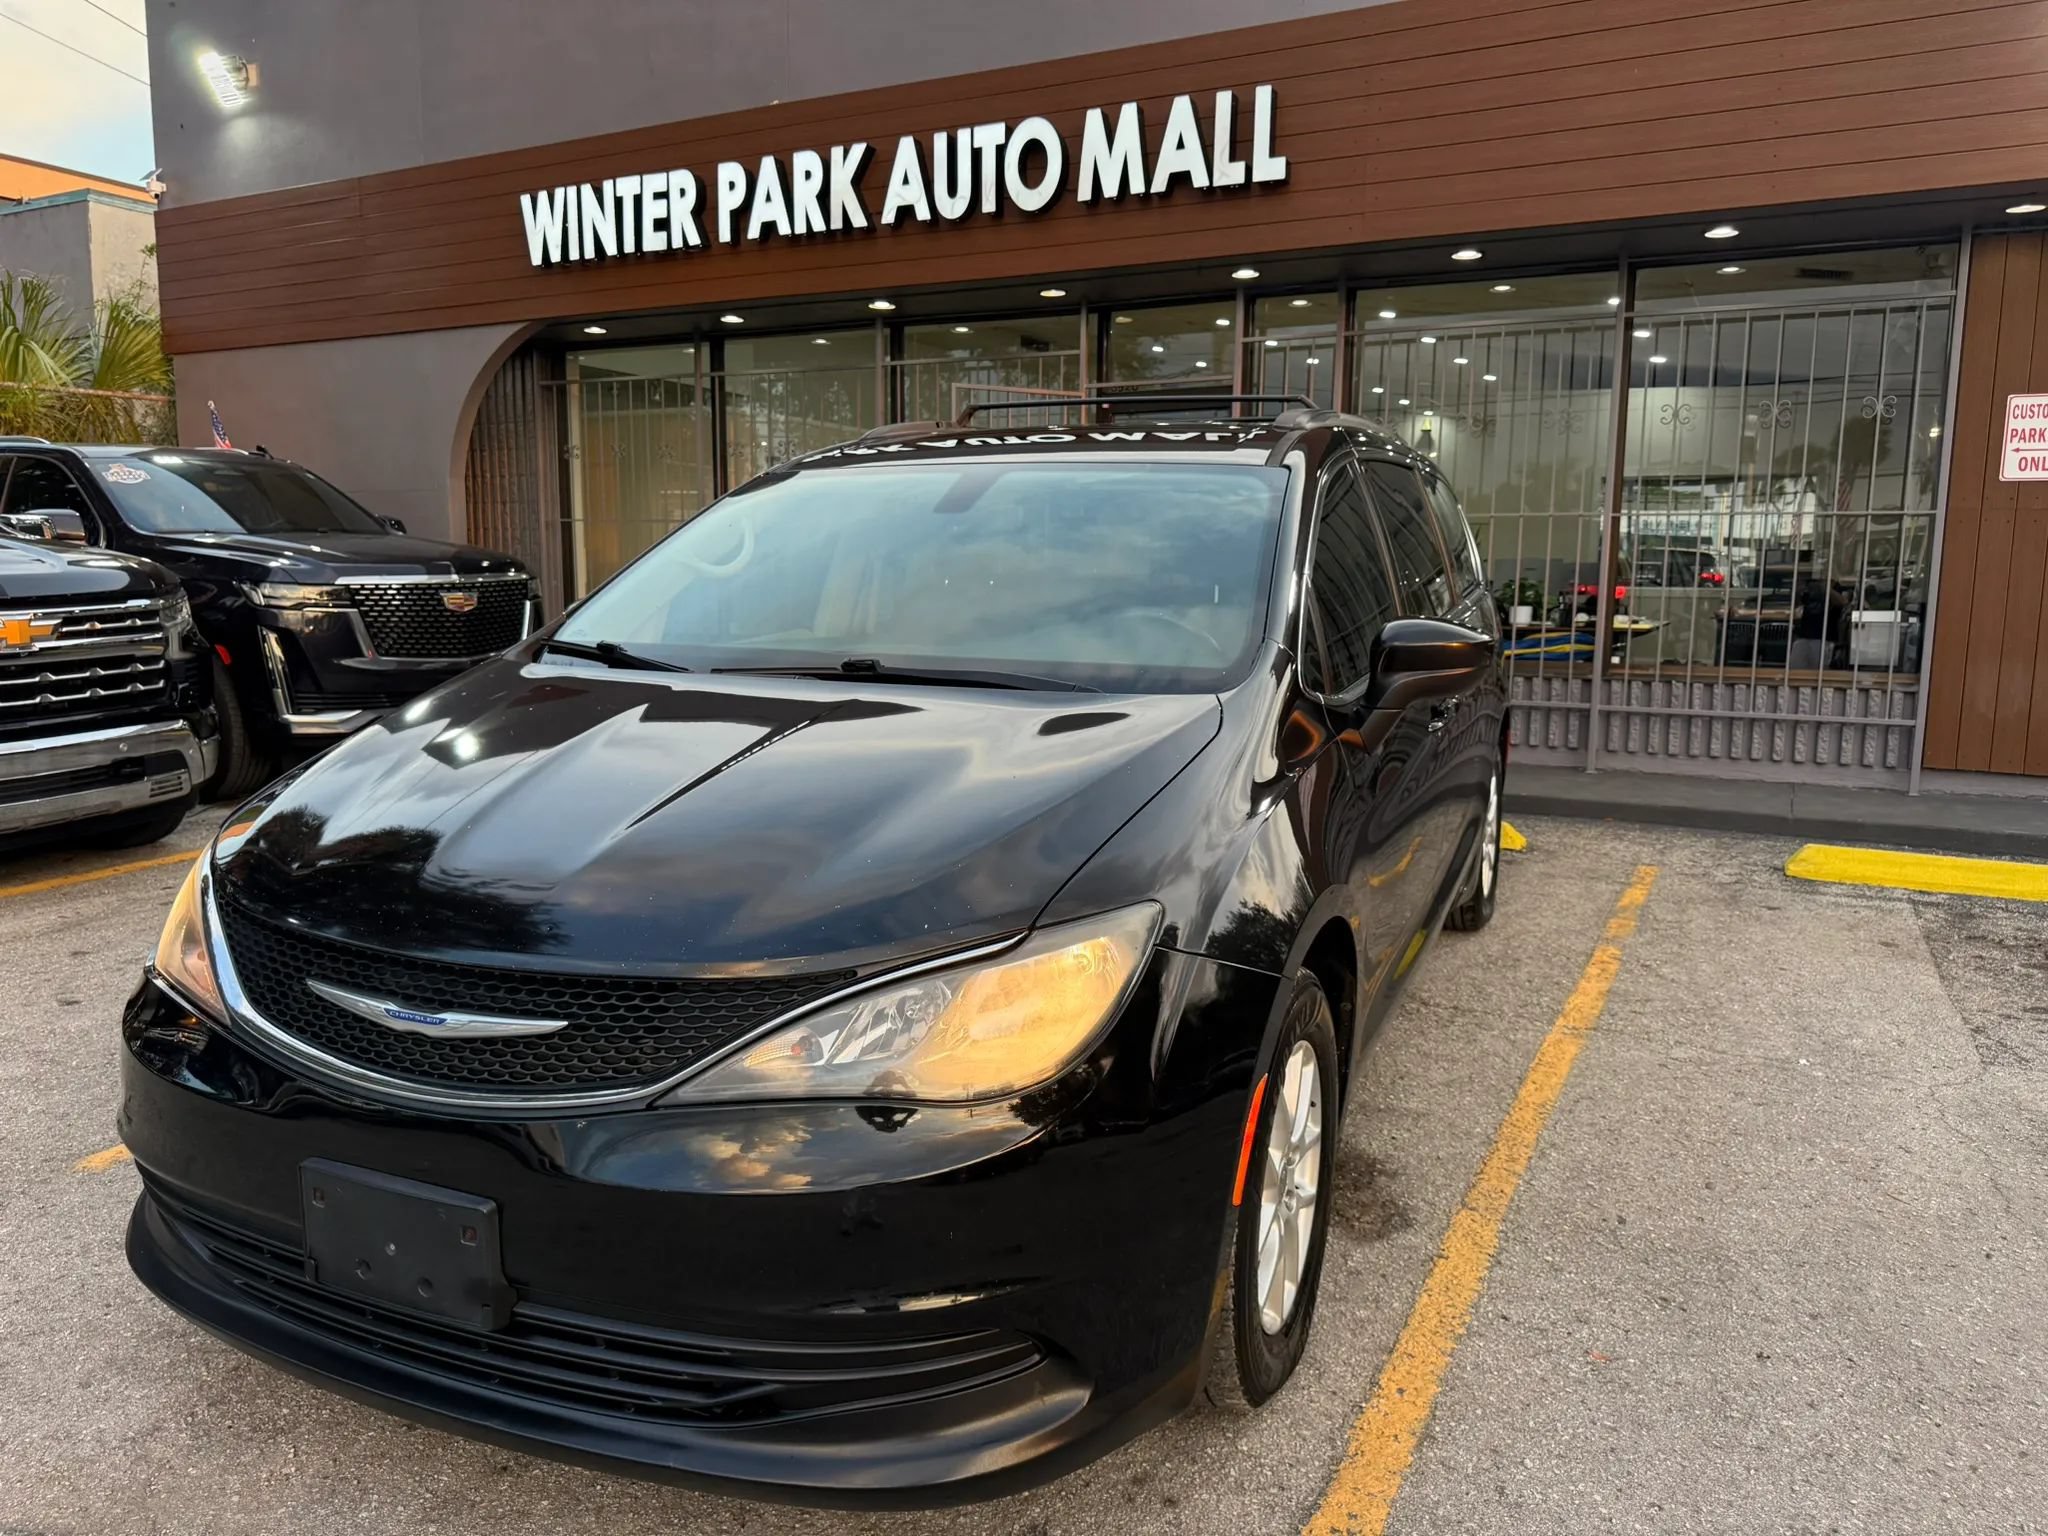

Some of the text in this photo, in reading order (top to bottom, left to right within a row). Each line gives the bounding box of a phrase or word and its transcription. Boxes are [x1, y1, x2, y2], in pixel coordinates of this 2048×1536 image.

[520, 85, 1287, 267] WINTER PARK AUTO MALL
[2018, 456, 2048, 472] ONL
[389, 1010, 441, 1025] CHRYSLER
